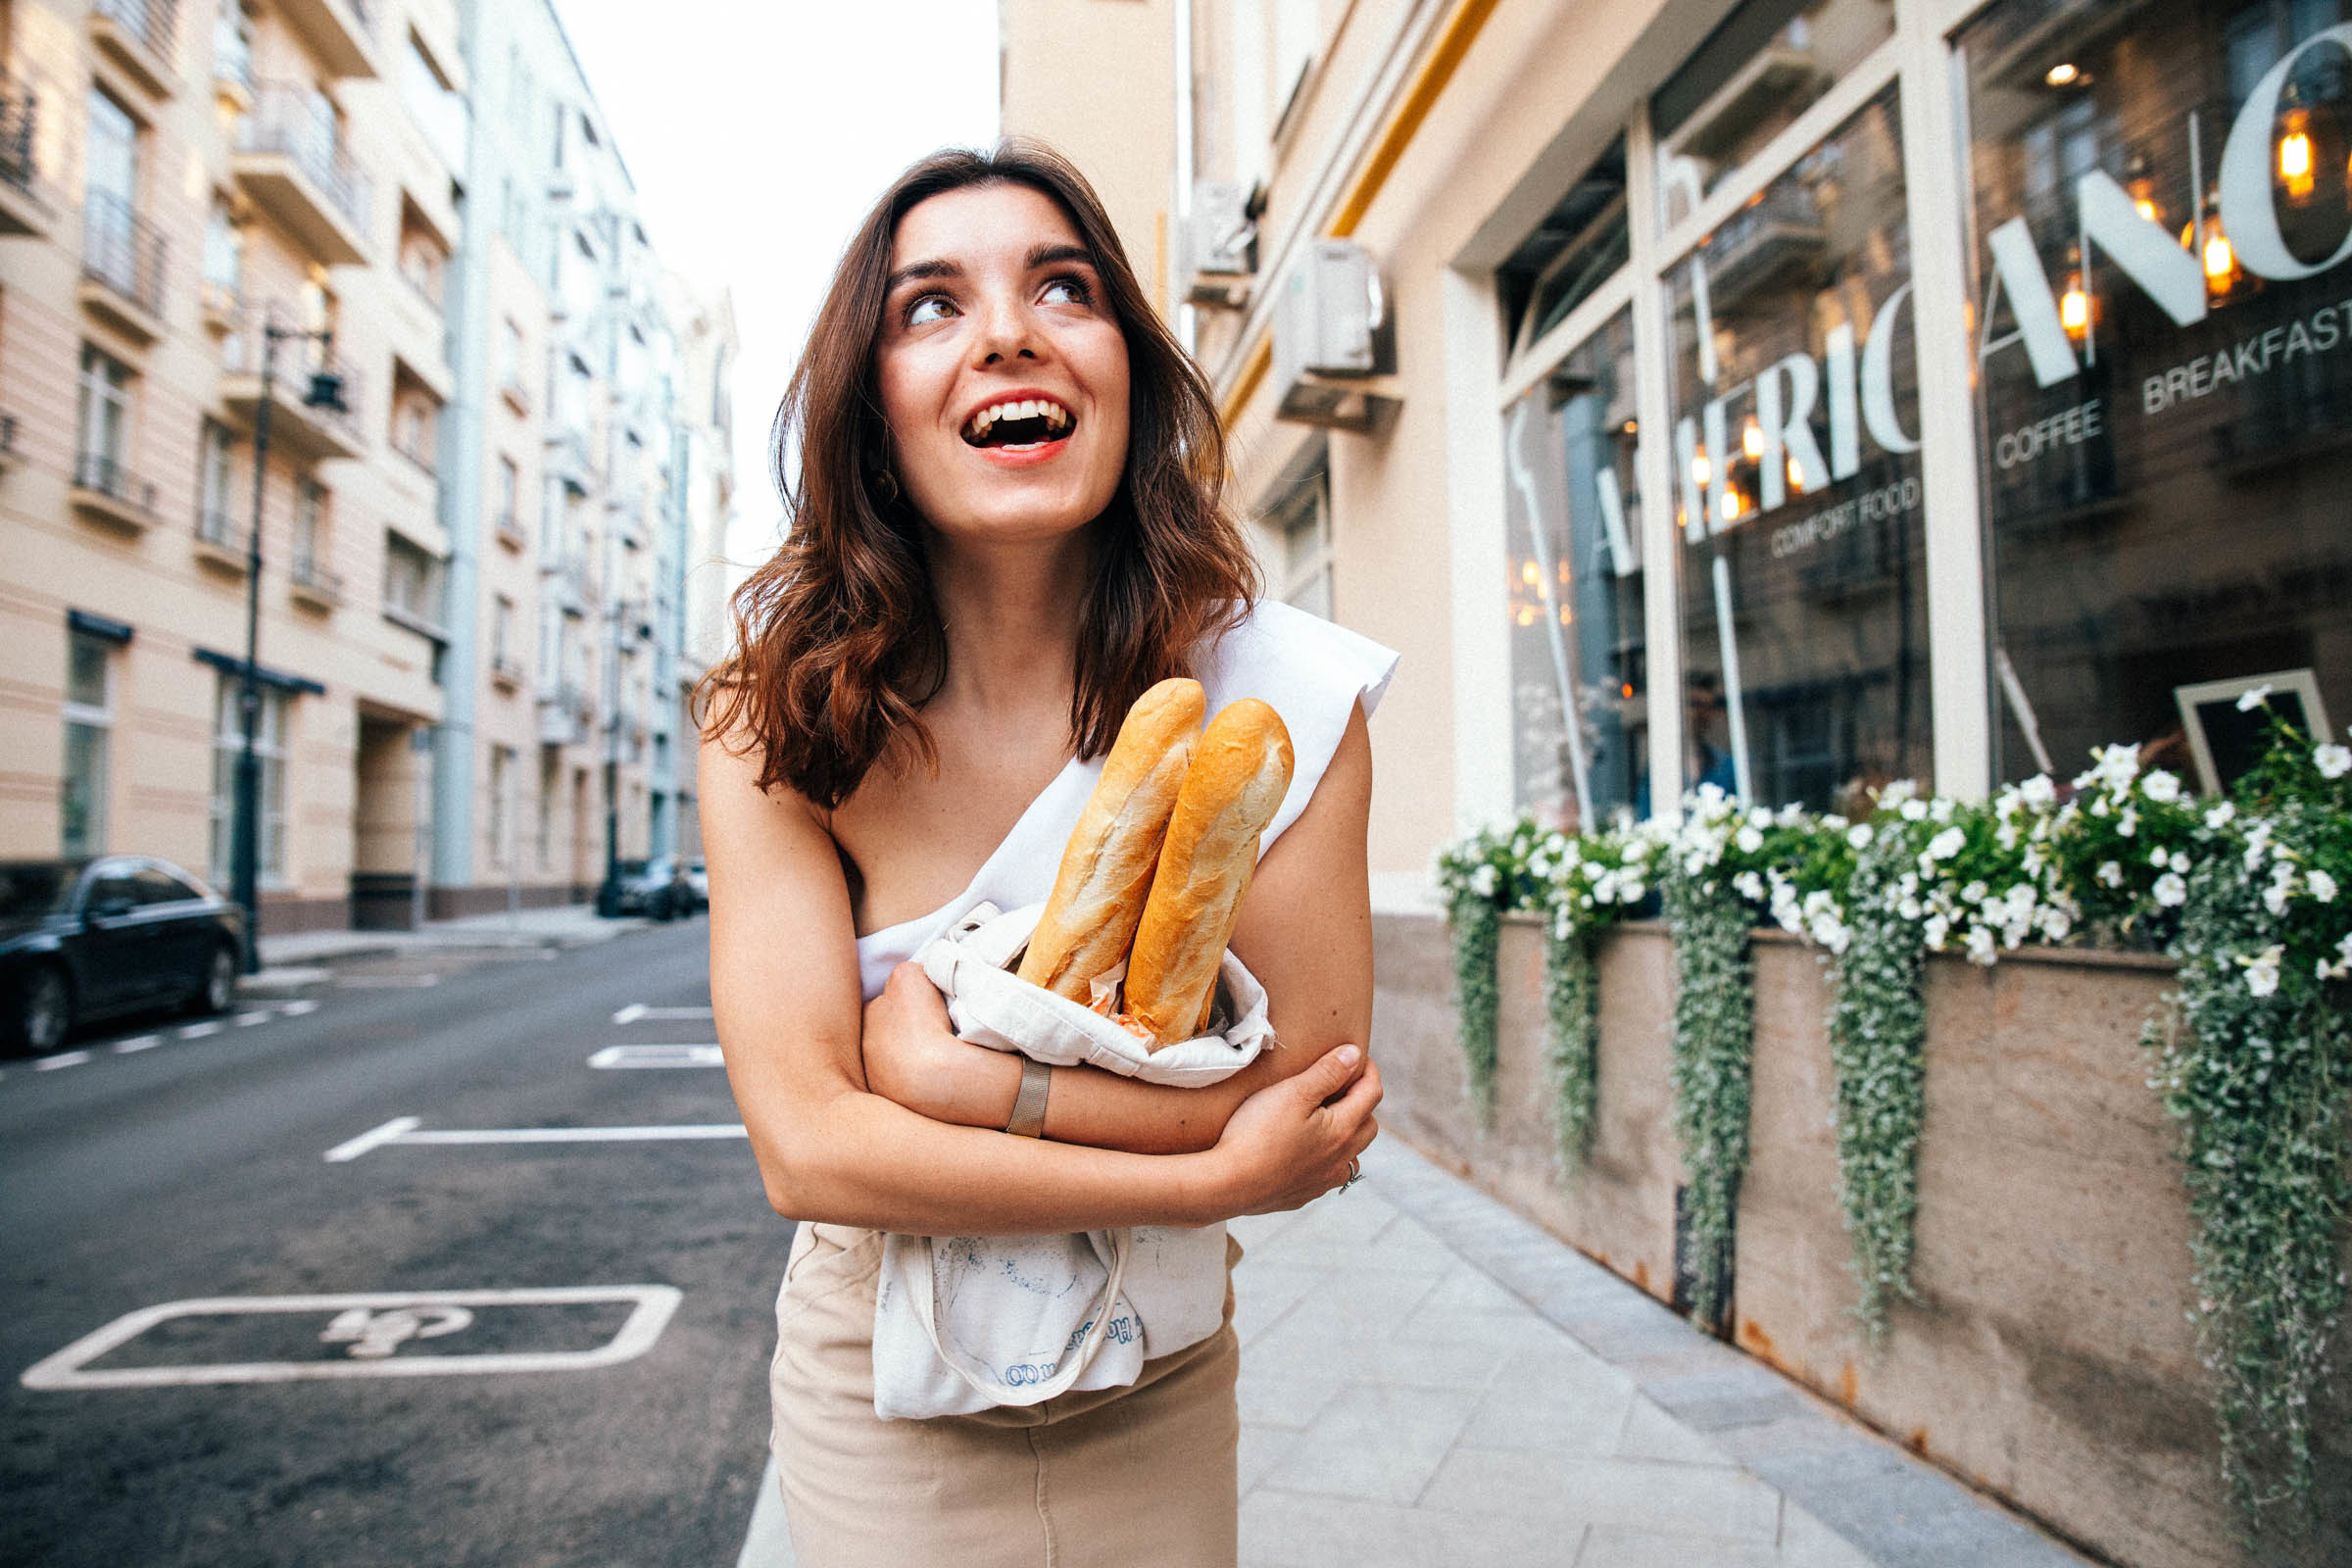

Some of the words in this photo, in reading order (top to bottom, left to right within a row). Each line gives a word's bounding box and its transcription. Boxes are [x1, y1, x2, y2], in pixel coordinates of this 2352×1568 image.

[1995, 399, 2102, 469] COFFEE
[1770, 500, 1857, 559] COMFORT
[1858, 476, 1922, 523] FOOD
